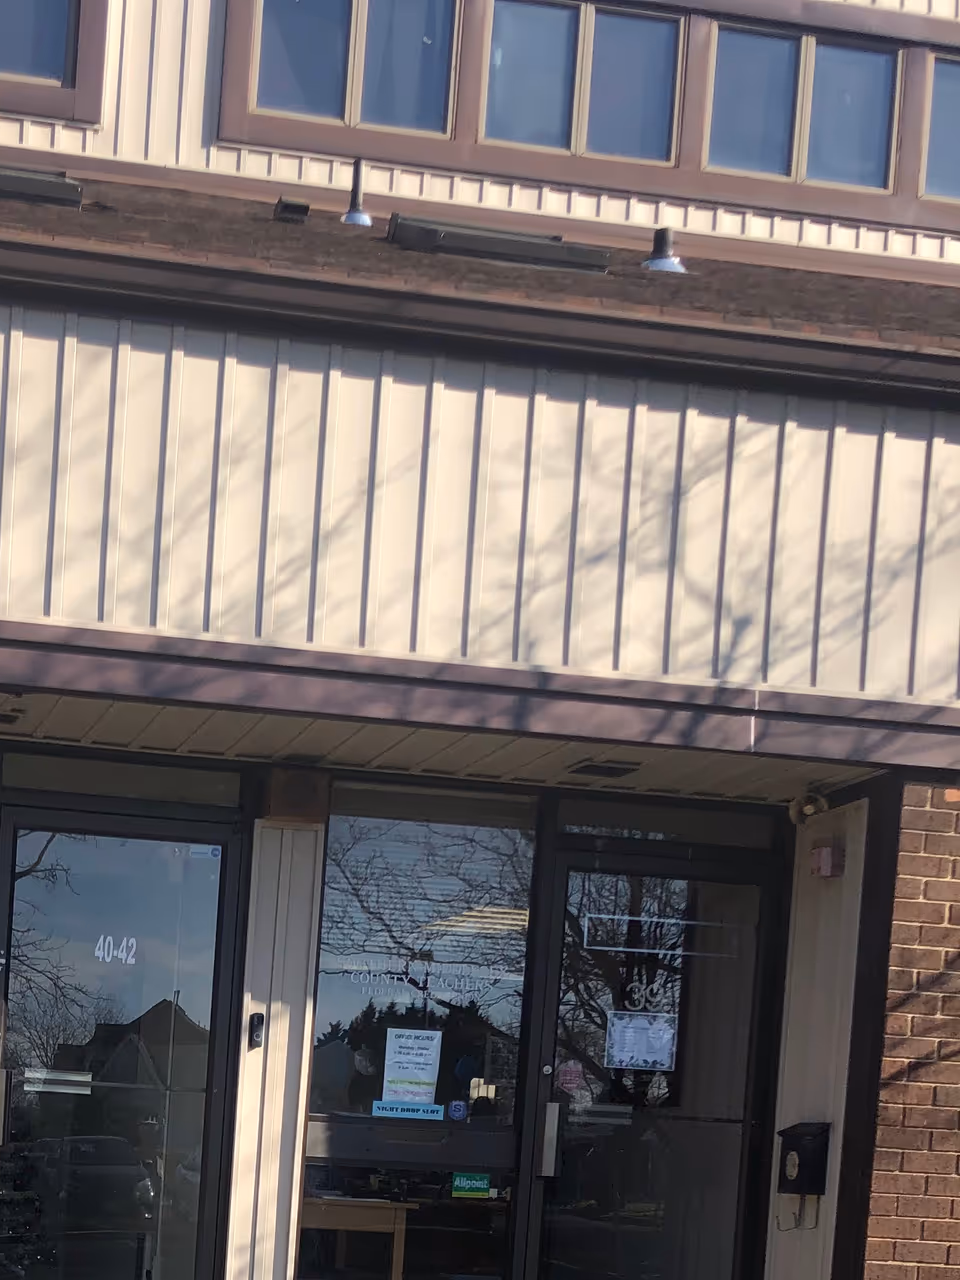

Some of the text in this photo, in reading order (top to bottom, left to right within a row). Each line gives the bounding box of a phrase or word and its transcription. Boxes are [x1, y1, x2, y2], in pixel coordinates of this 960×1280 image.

[94, 934, 137, 965] 40-42
[350, 971, 494, 991] COUNTY TEACHERS
[624, 982, 664, 1011] 39
[454, 1176, 489, 1190] Allpoint
